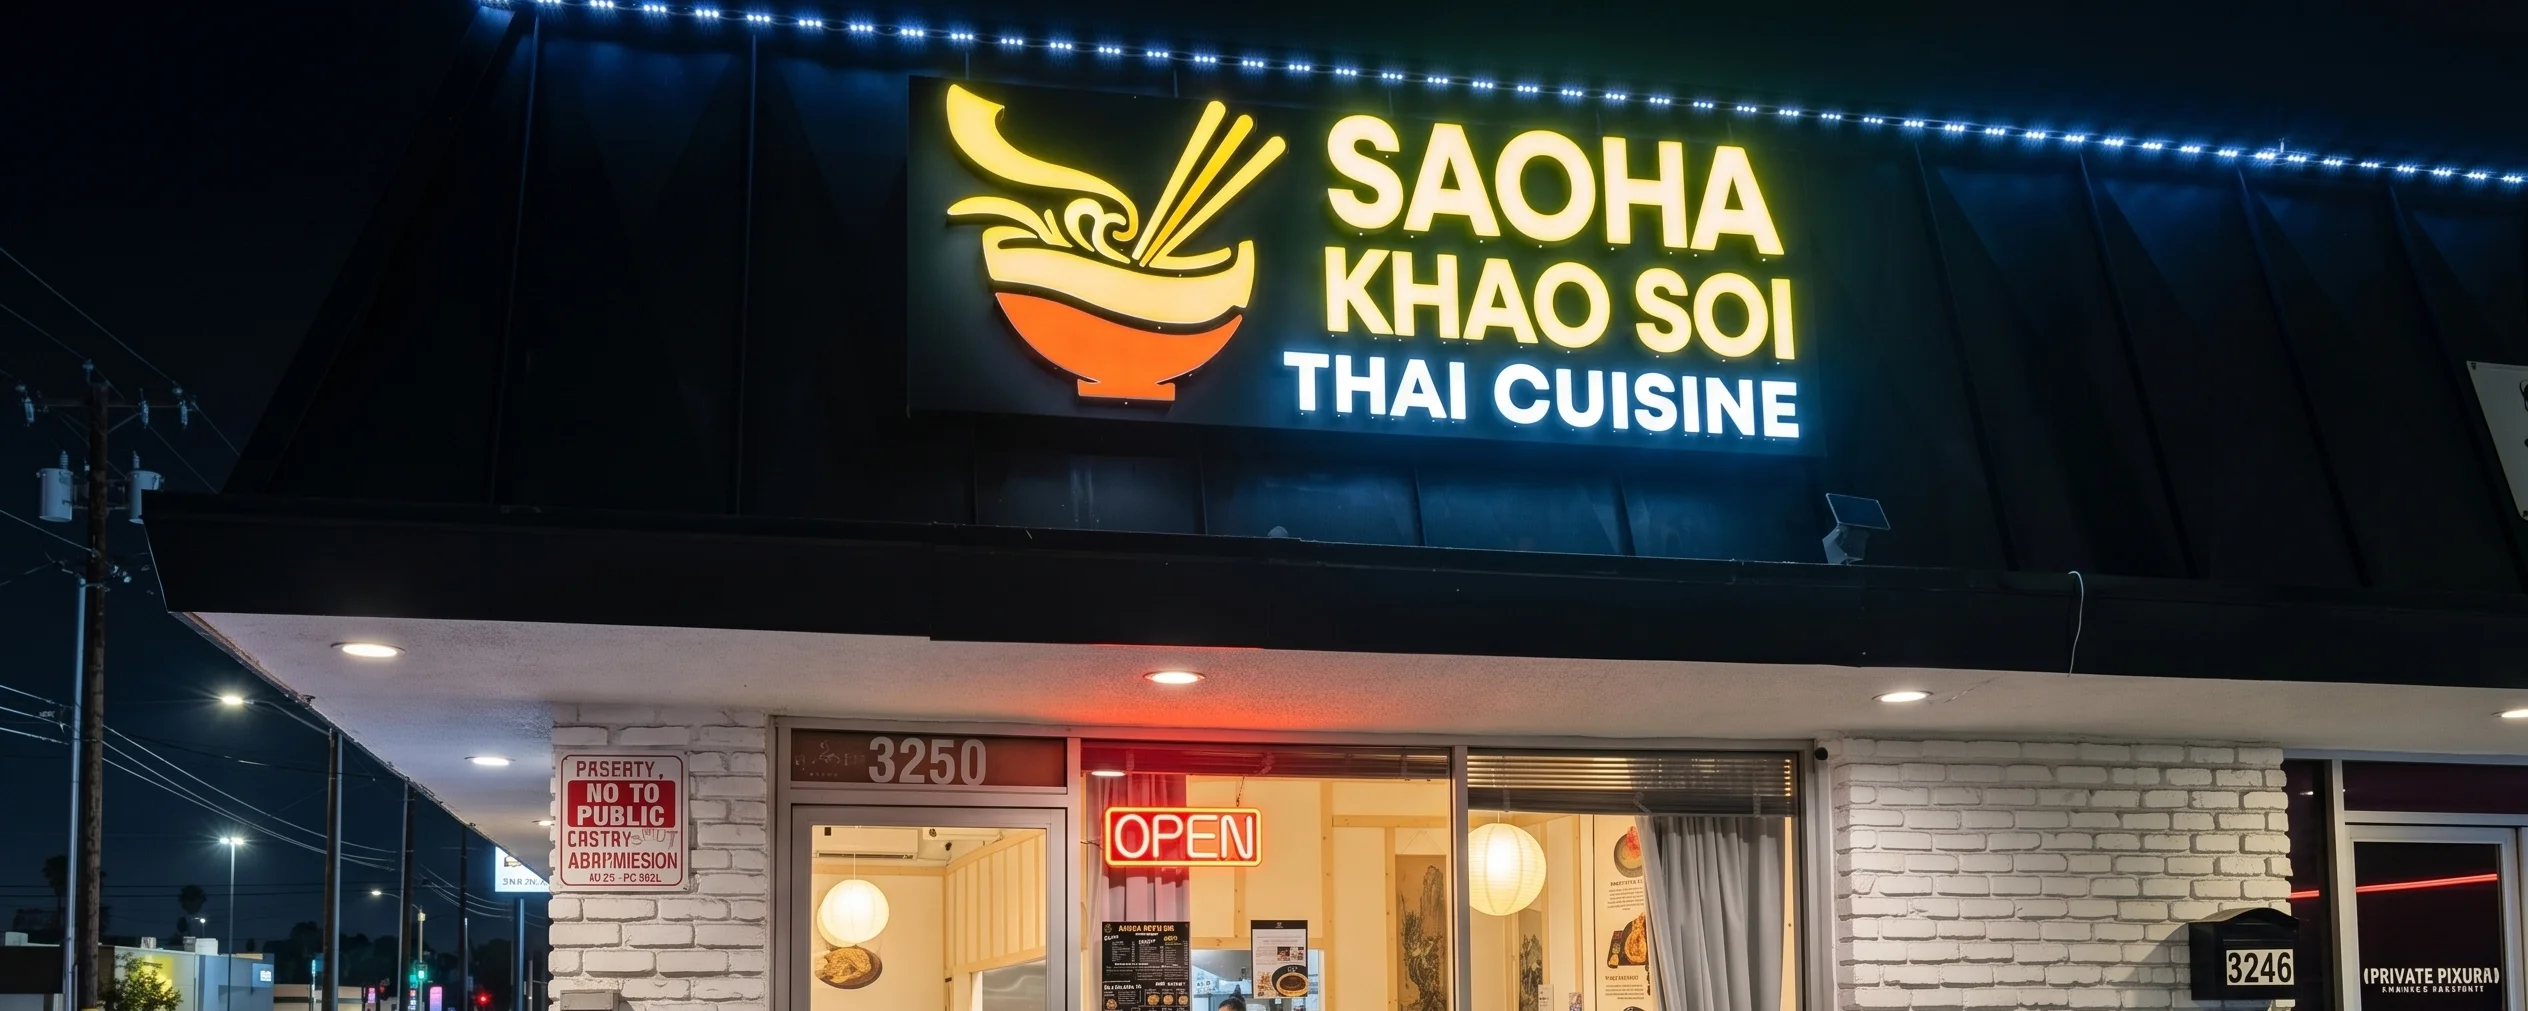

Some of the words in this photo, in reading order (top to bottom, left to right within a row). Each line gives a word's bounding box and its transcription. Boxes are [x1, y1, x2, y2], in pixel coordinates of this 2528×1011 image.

[1327, 114, 1784, 256] SAOHA
[1325, 246, 1610, 349] KHAO
[1635, 267, 1796, 360] SOI
[1284, 350, 1466, 420] THAI
[1493, 362, 1800, 438] CUISINE
[868, 736, 987, 786] 3250
[577, 804, 665, 827] PUBLIC
[586, 782, 619, 804] NO
[629, 782, 660, 804] TO
[1114, 813, 1254, 860] OPEN
[623, 873, 637, 882] PC
[2227, 952, 2292, 984] 3246
